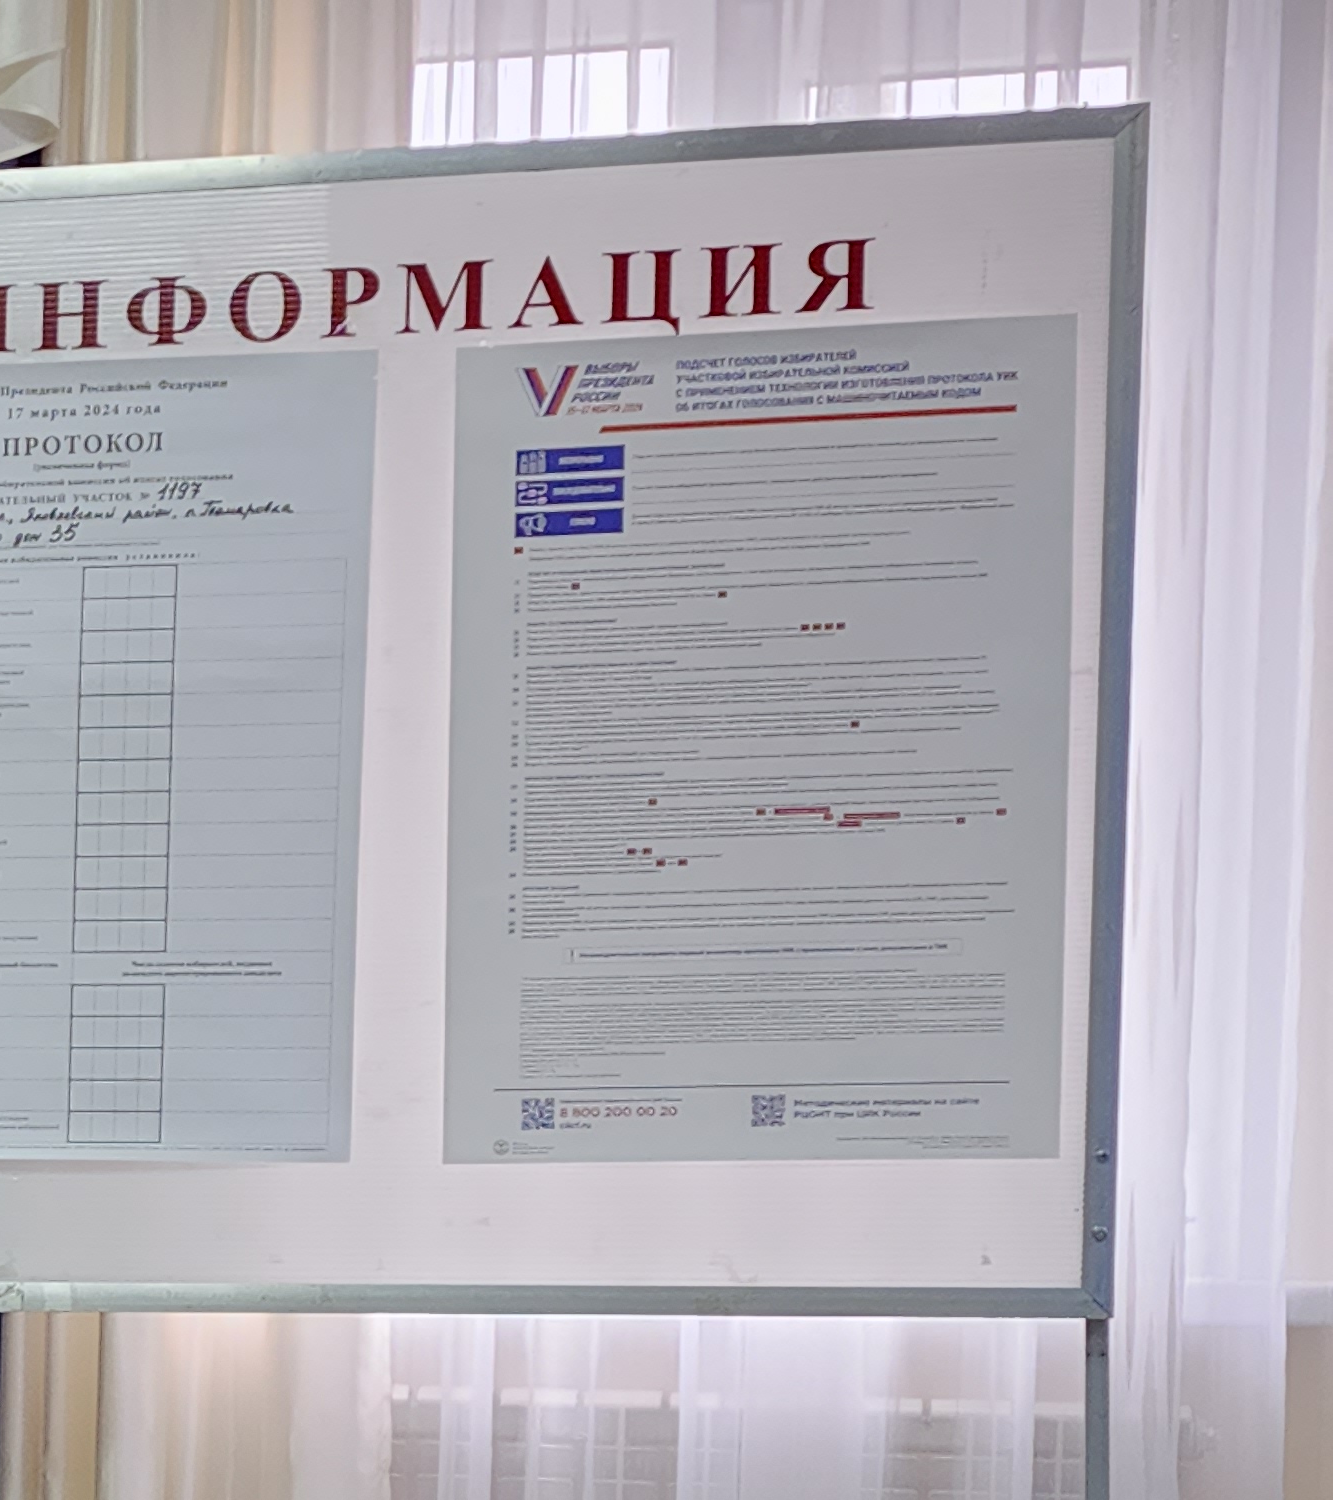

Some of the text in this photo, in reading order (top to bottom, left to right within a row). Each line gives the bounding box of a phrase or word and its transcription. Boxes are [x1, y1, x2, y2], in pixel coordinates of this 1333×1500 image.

[7, 403, 161, 421] 17 марта 2024 года
[2, 431, 164, 457] ПРОТОКОЛ
[156, 481, 203, 500] 1197
[48, 521, 81, 544] 35
[572, 1107, 600, 1118] 800
[604, 1106, 632, 1117] 200
[636, 1106, 656, 1117] 00
[660, 1106, 678, 1117] 20
